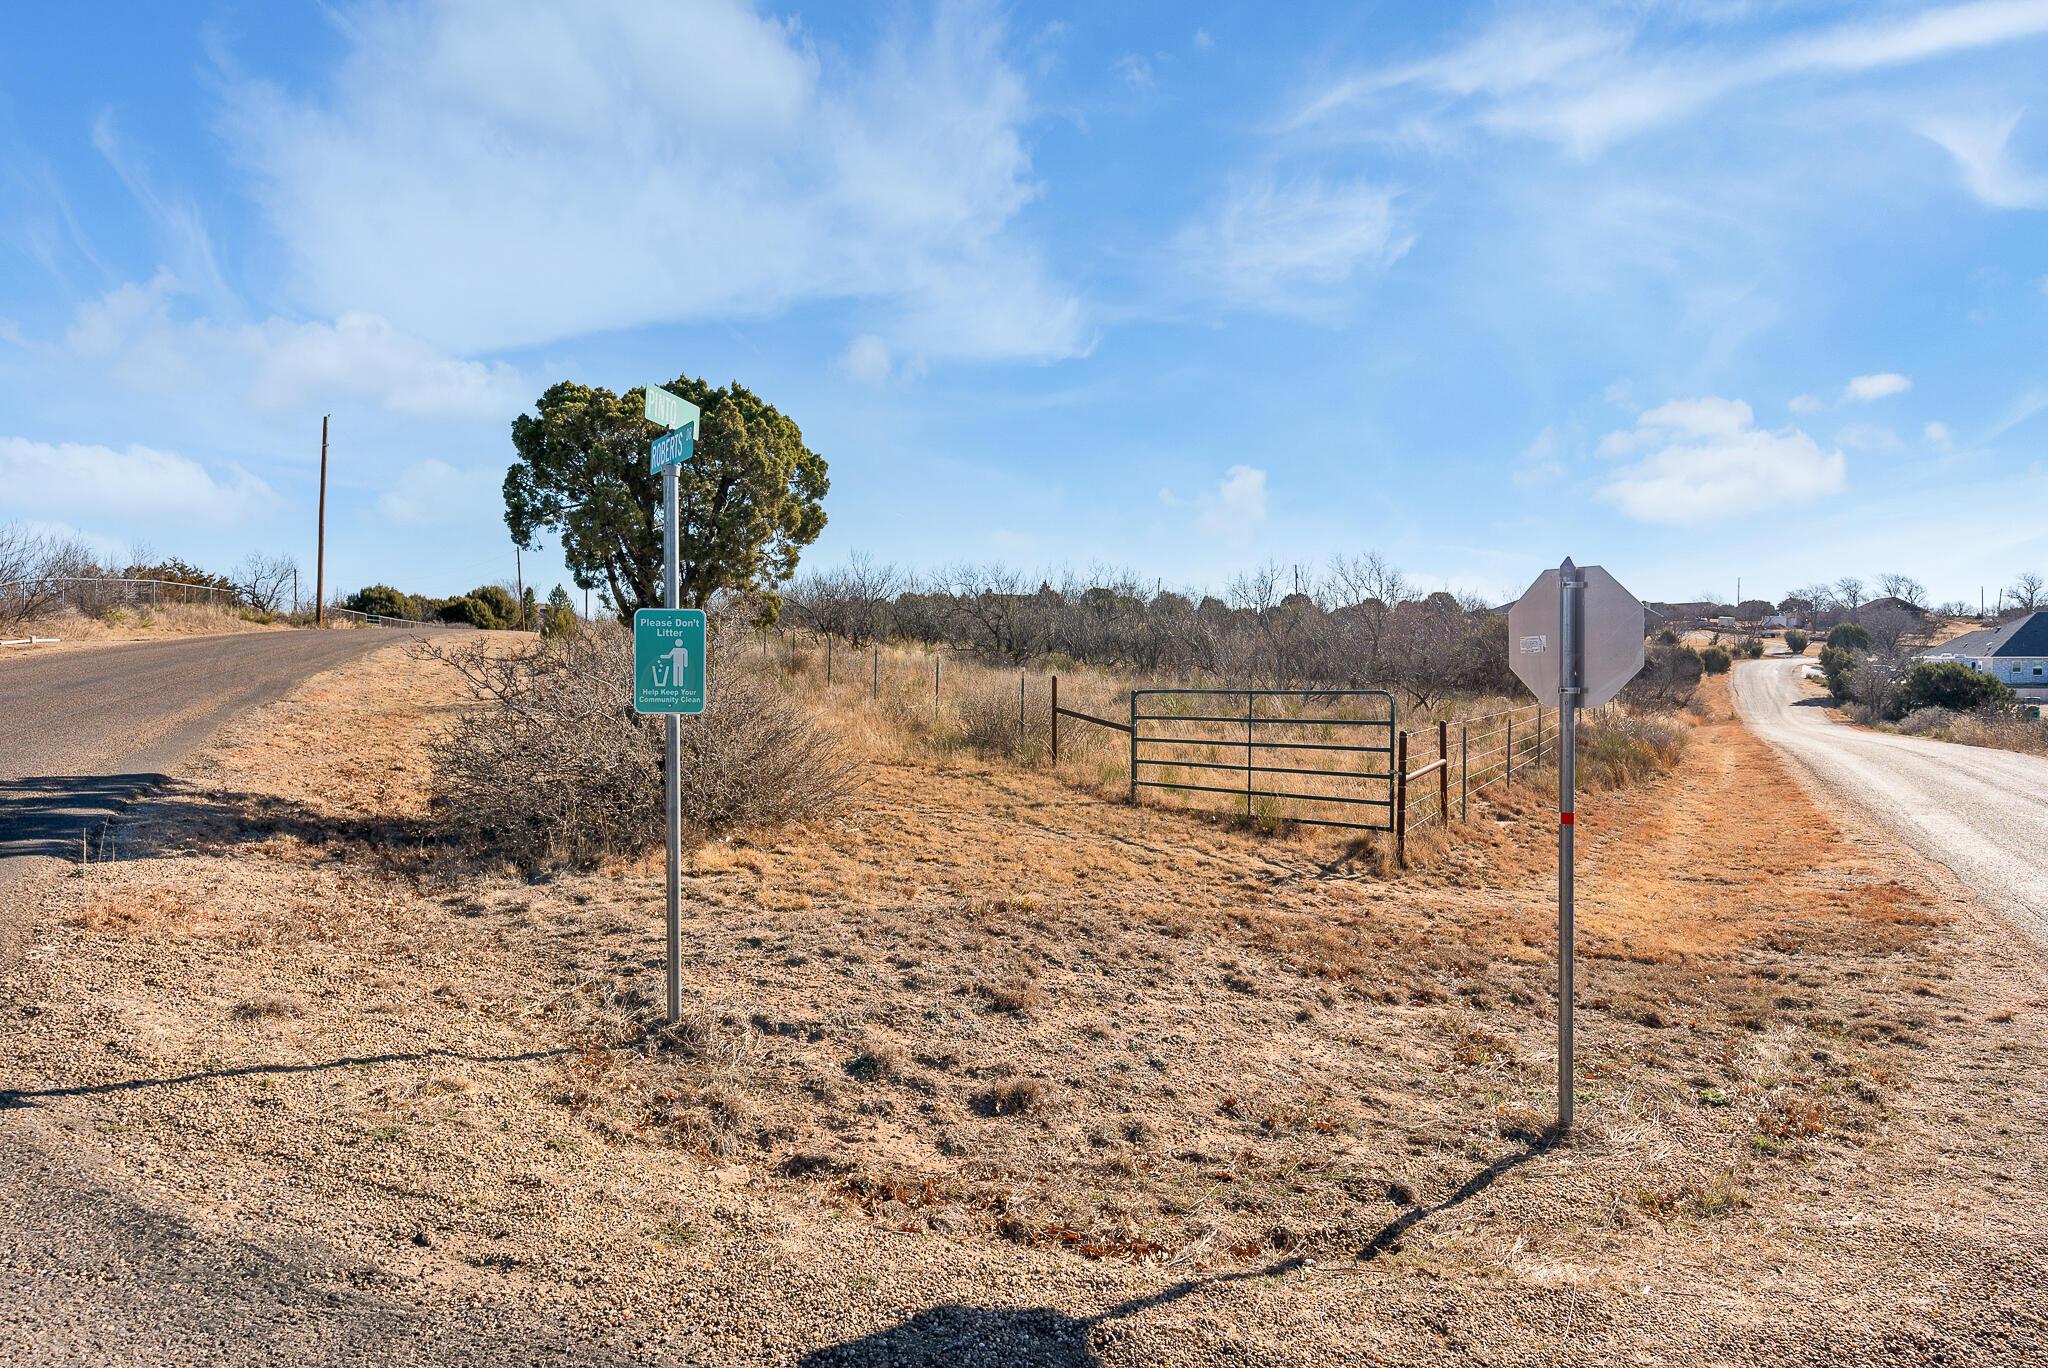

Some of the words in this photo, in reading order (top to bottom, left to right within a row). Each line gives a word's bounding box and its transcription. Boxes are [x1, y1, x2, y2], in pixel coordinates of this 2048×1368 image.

[648, 390, 677, 424] PINTO
[652, 432, 683, 467] ROBERTS
[640, 618, 672, 627] Please
[675, 618, 700, 627] Don't
[657, 629, 683, 637] Litter
[639, 696, 679, 704] Community
